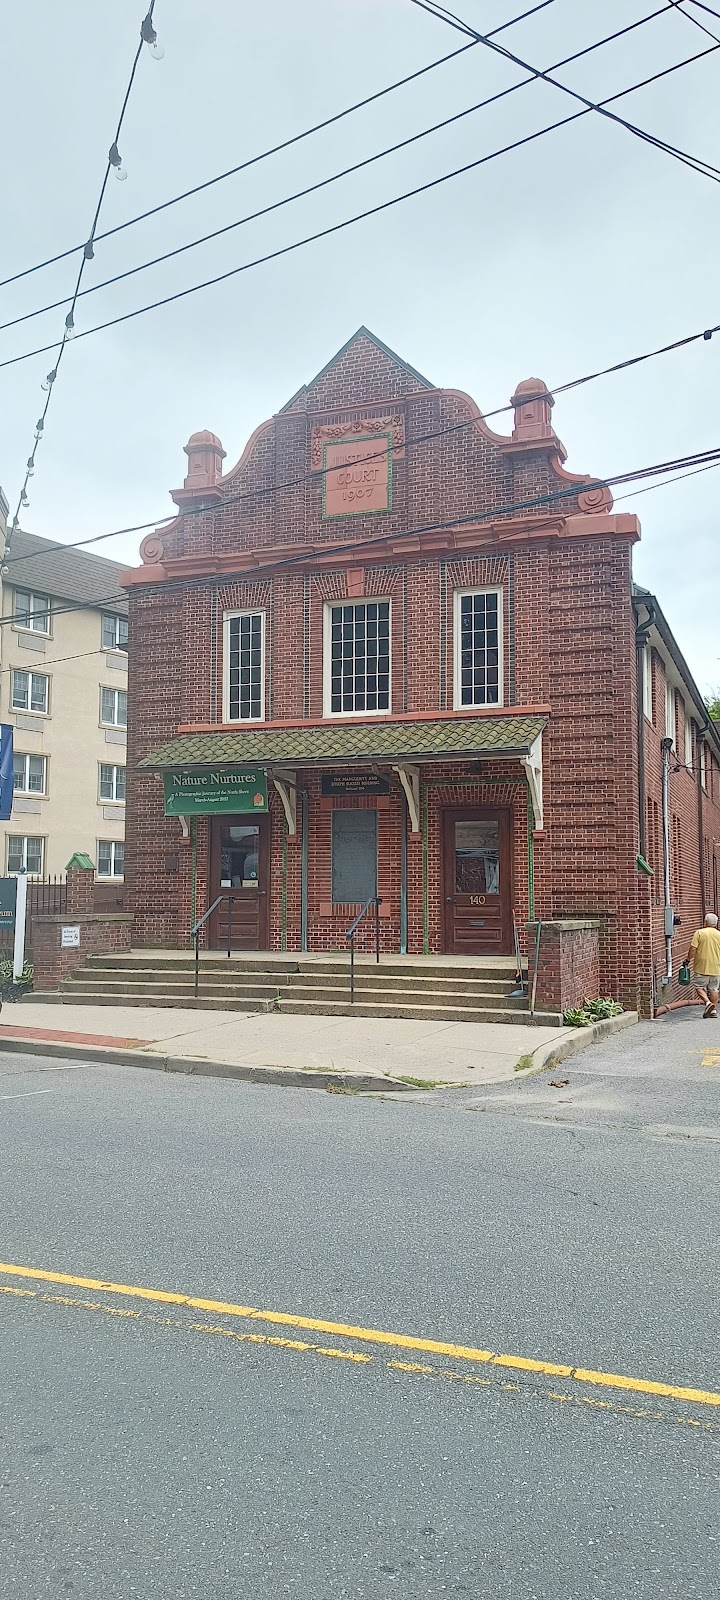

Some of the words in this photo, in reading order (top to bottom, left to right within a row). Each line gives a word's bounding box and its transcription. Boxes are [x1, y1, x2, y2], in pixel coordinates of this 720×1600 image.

[337, 469, 380, 485] COURT
[342, 488, 374, 502] 1907
[172, 774, 208, 785] Nature
[209, 773, 256, 785] Nurtures
[469, 895, 486, 905] 140
